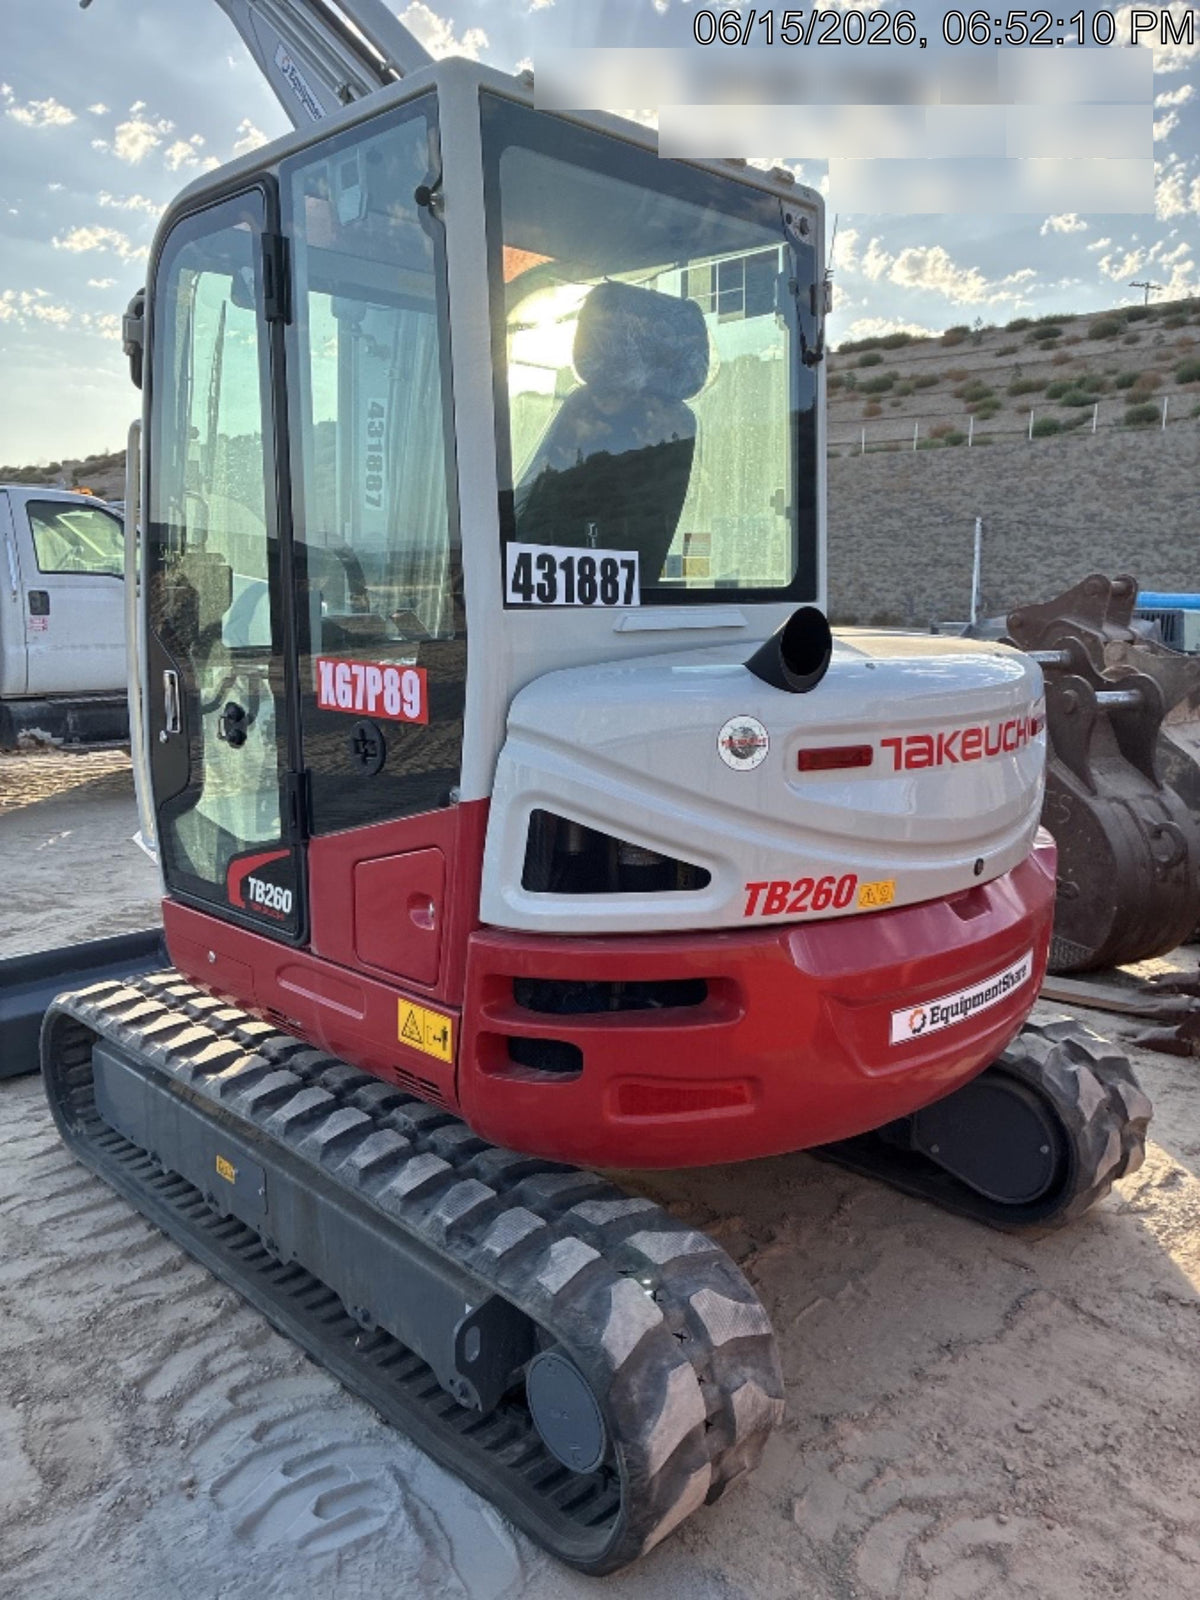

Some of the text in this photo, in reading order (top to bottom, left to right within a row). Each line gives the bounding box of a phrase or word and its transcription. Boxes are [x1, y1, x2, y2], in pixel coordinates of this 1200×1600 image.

[366, 401, 384, 507] 431887
[511, 552, 636, 605] 431887
[248, 876, 292, 914] TB260
[743, 873, 858, 917] TB260
[929, 964, 1027, 1024] EquipmentShare
